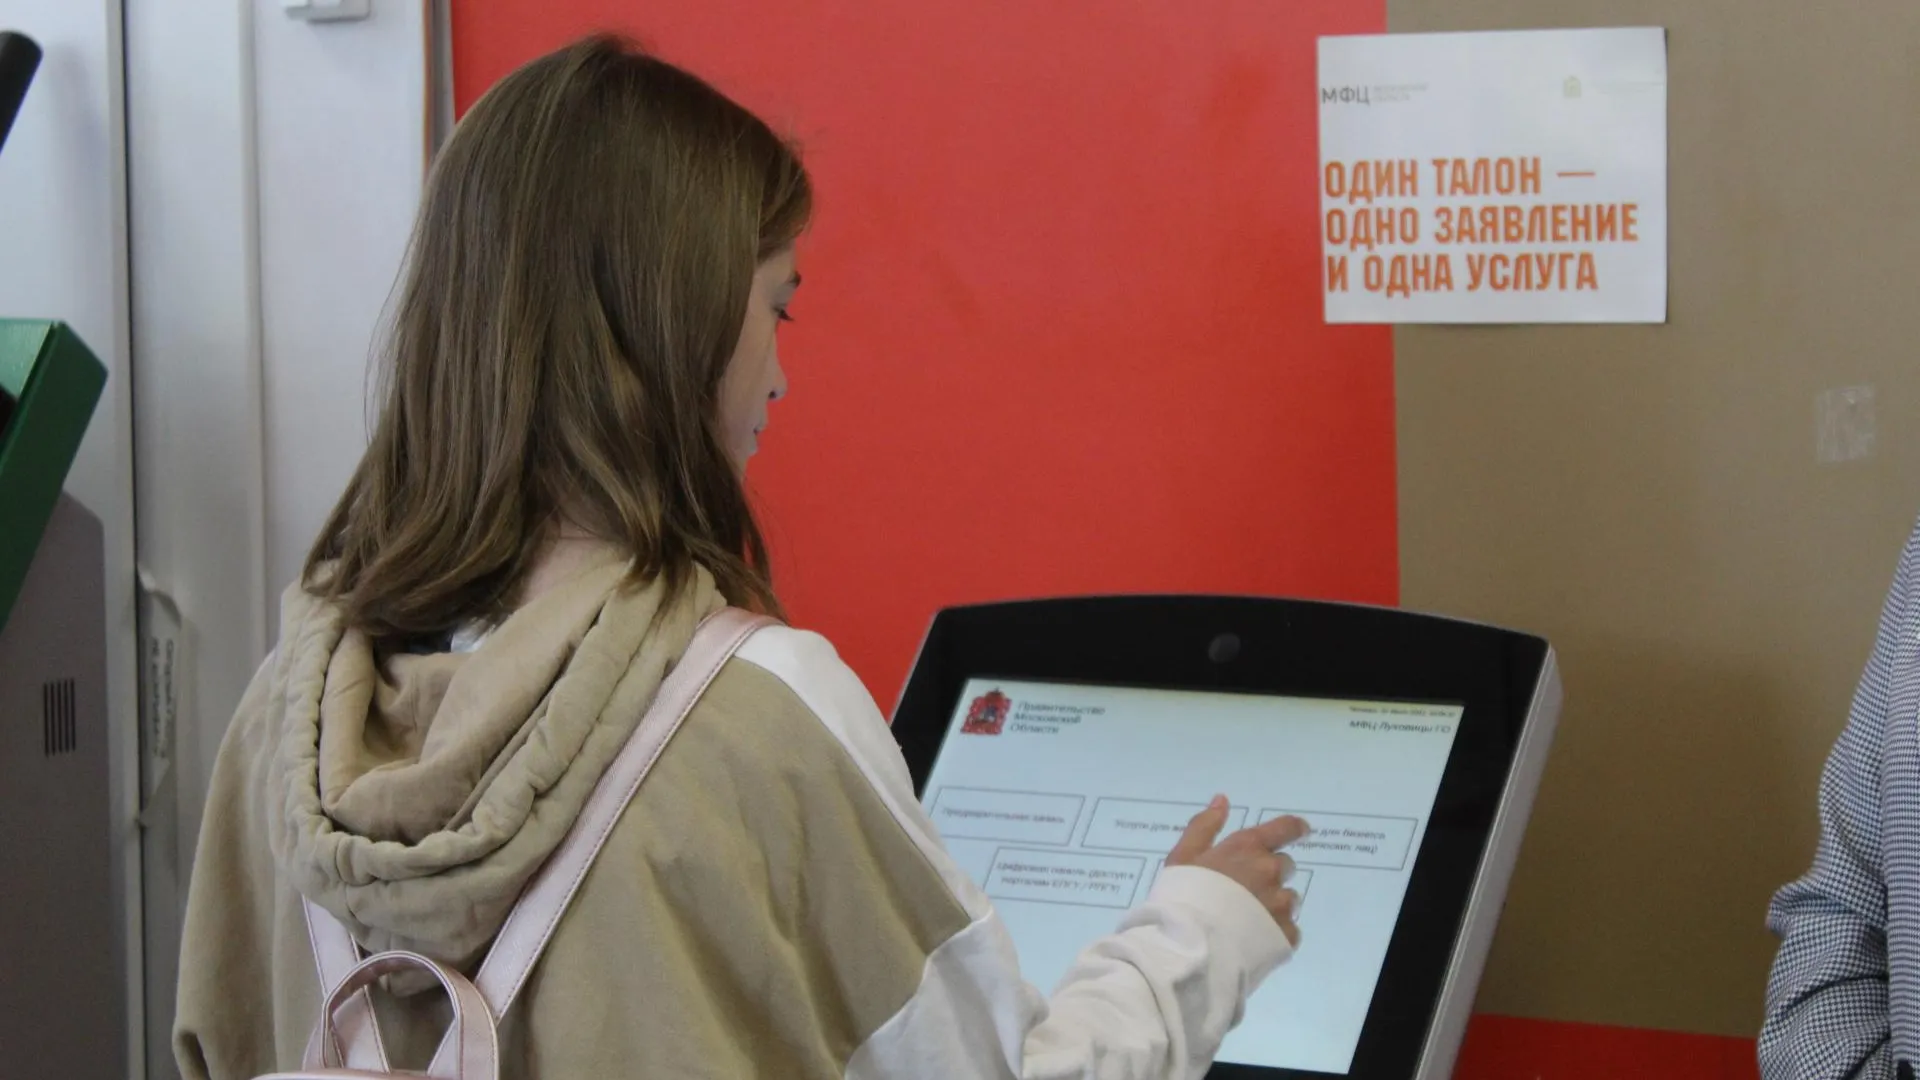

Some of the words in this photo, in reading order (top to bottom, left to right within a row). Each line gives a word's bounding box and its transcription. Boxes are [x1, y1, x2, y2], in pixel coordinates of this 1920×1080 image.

[1322, 85, 1370, 106] МФЦ
[1324, 159, 1418, 204] ОДИН
[1432, 157, 1541, 196] ТАЛОН
[1326, 207, 1420, 251] ОДНО
[1434, 203, 1639, 244] ЗАЯВЛЕНИЕ
[1327, 255, 1348, 292] И
[1364, 253, 1454, 298] ОДНА
[1466, 252, 1598, 291] УСЛУГА
